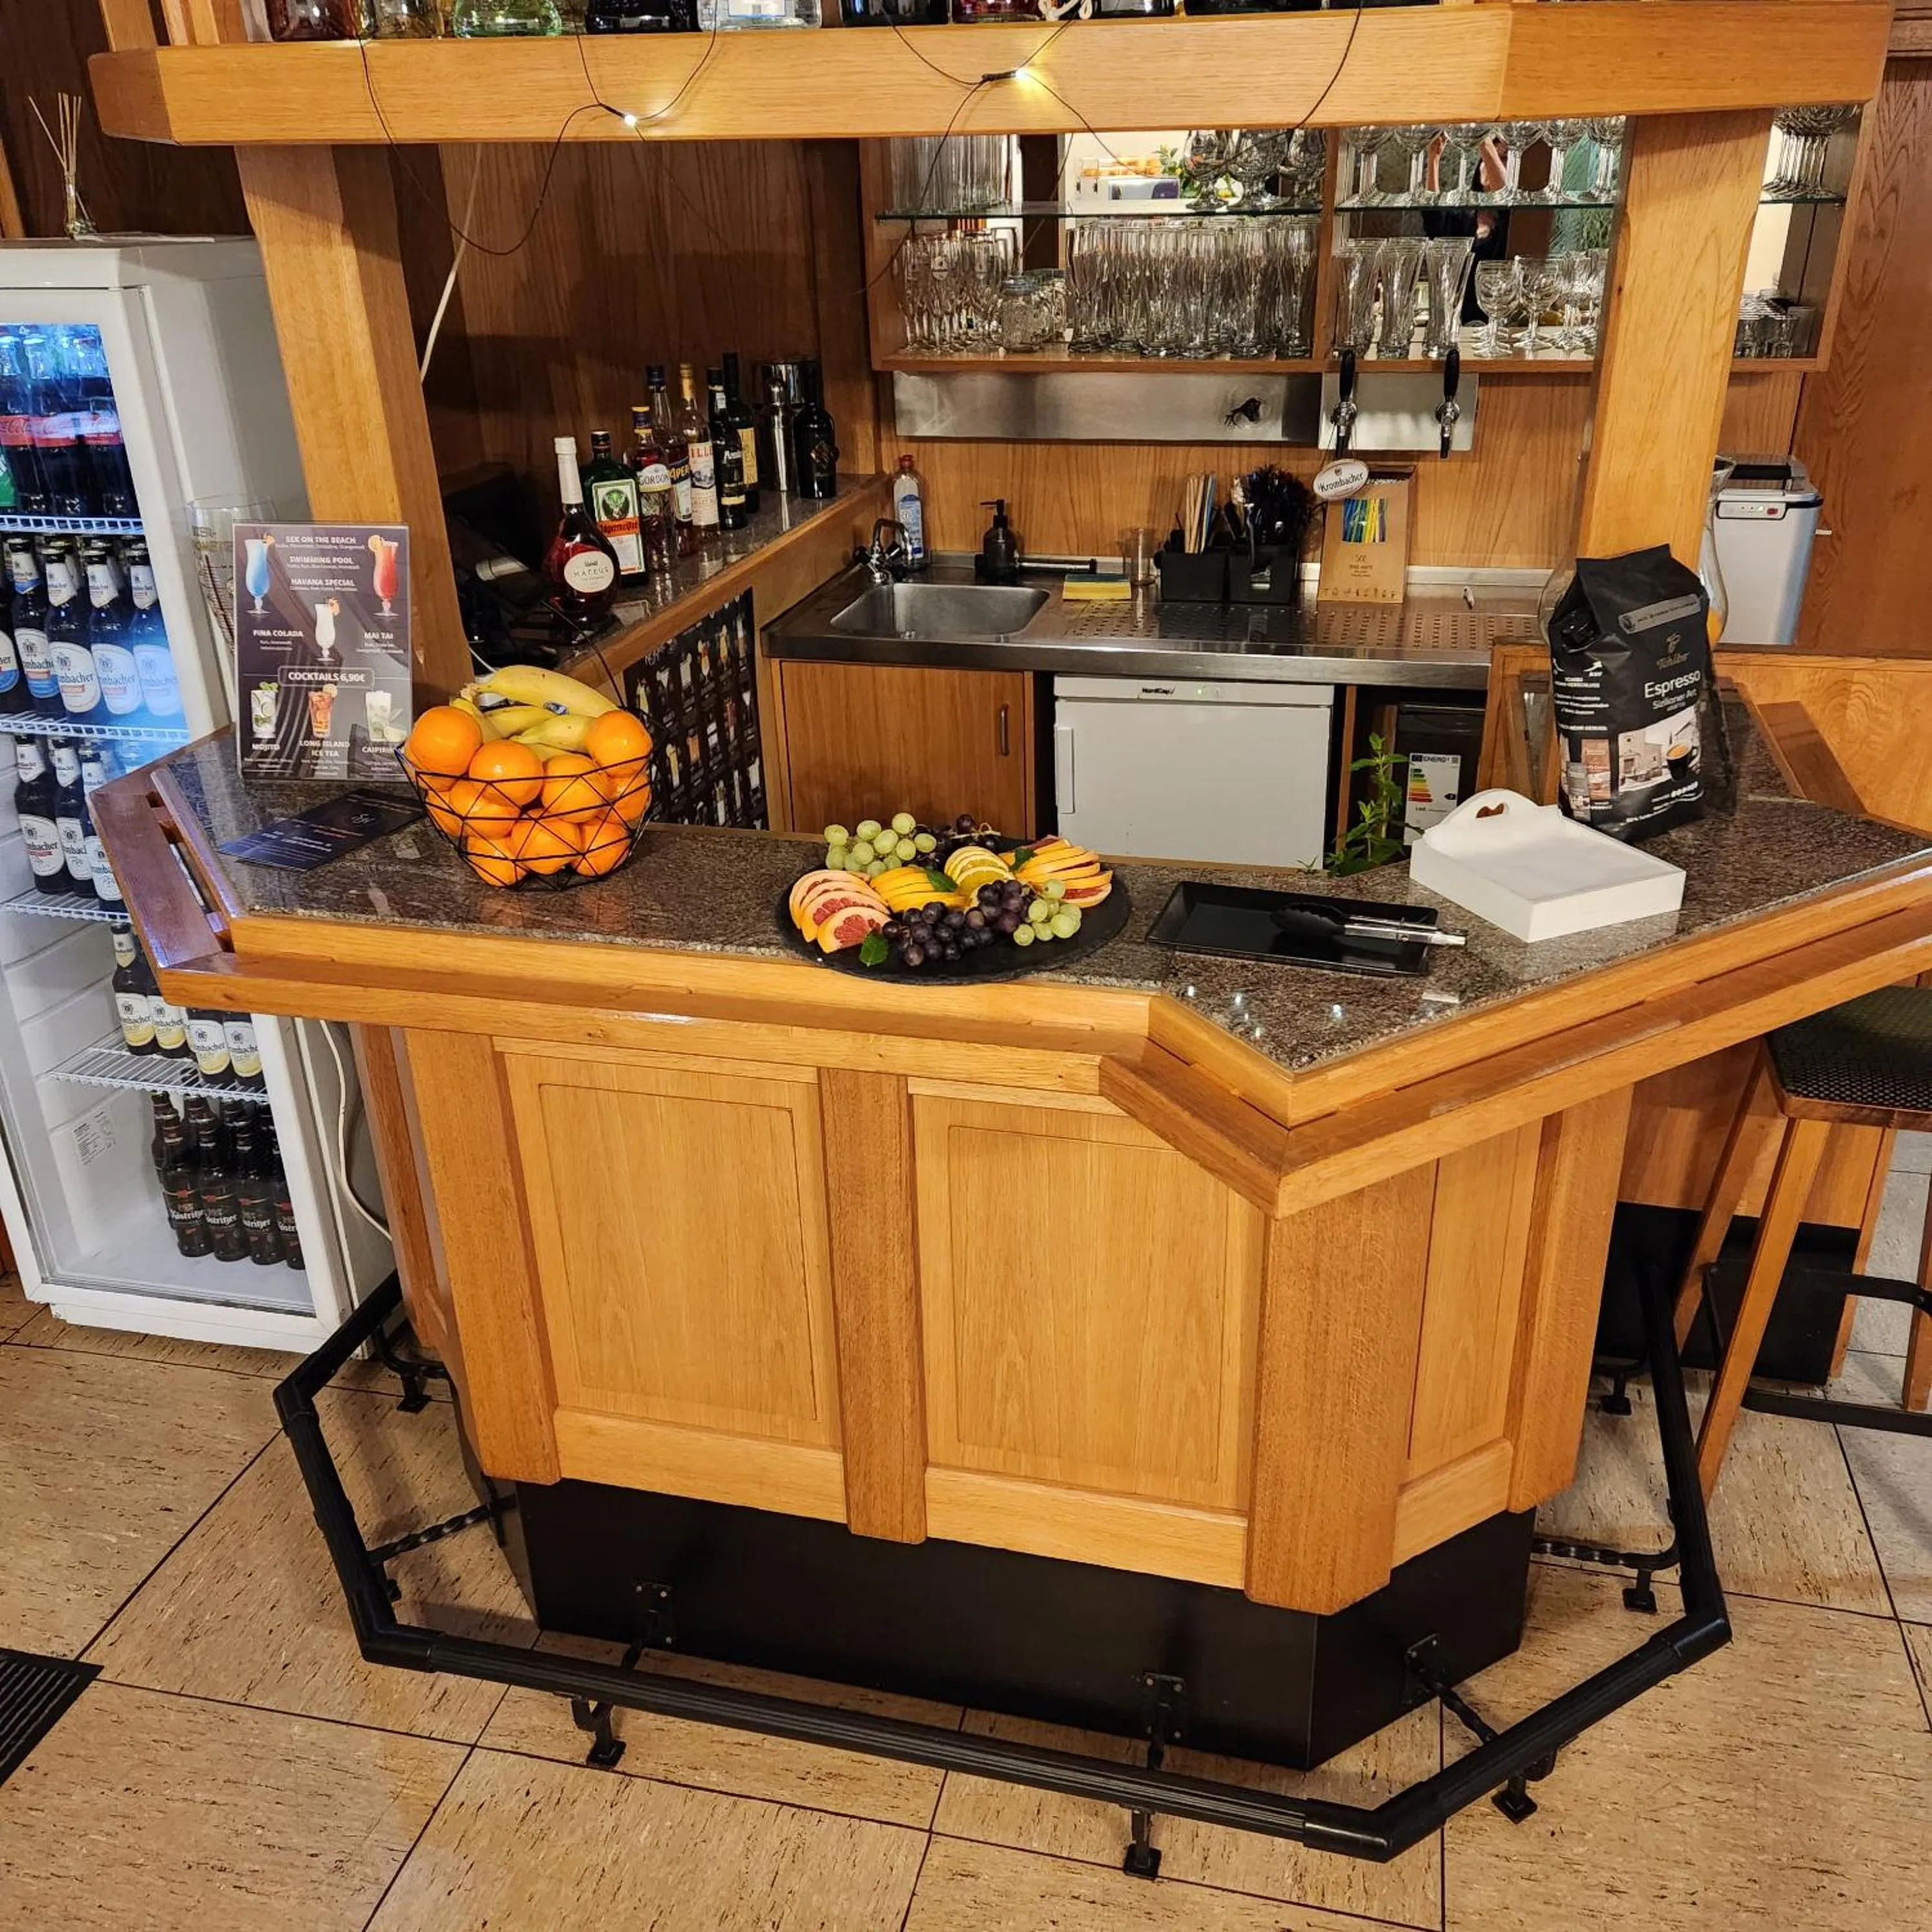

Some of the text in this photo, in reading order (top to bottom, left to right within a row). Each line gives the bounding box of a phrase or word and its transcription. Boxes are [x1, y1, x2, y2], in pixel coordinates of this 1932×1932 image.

[669, 464, 690, 480] APER
[1317, 472, 1364, 492] Krombacher
[288, 672, 366, 683] COCKTAILS 6,90€
[1644, 670, 1701, 699] Espresso
